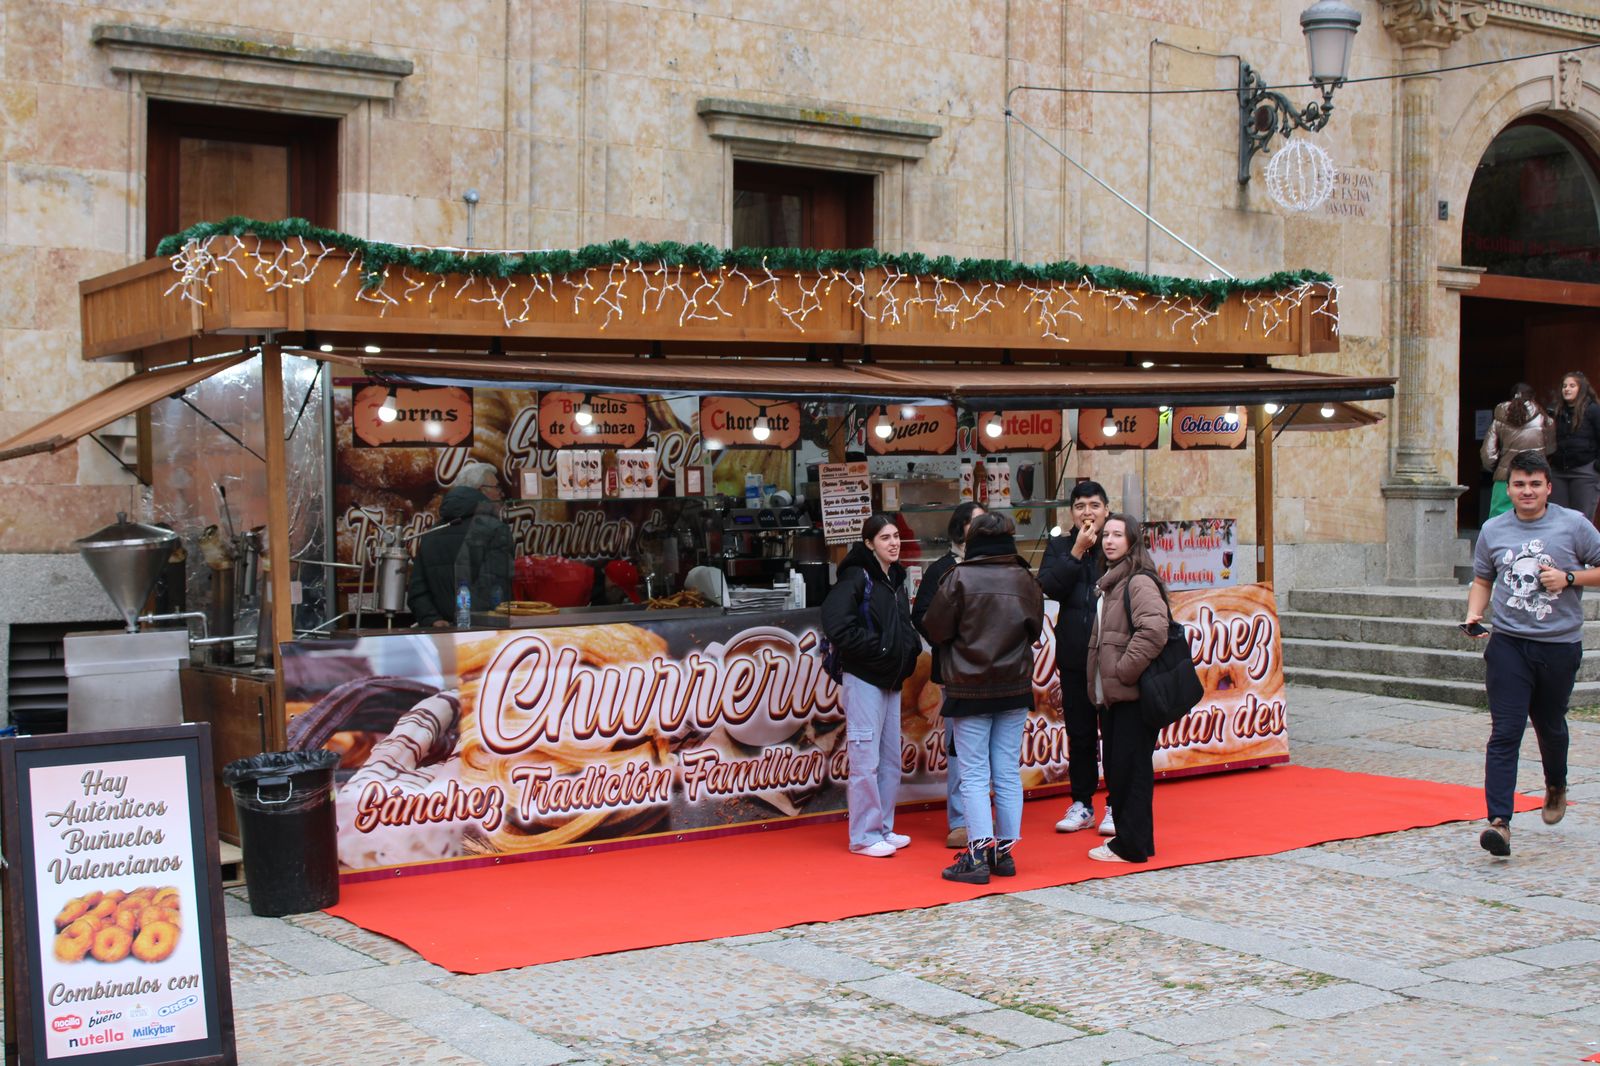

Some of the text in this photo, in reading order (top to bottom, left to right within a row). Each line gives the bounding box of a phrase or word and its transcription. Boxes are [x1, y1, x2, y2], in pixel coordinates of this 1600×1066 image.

[559, 399, 628, 414] Buuelos
[549, 421, 565, 434] de
[988, 414, 1053, 436] utella
[1101, 415, 1137, 433] afé
[1180, 415, 1240, 433] Cola Cao
[1184, 606, 1273, 681] chez
[80, 769, 128, 797] Hay
[355, 780, 504, 834] Sánchez
[512, 759, 672, 821] Tradición
[683, 746, 823, 801] Familiar
[45, 798, 168, 828] Auténticos
[60, 825, 165, 854] Buñuelos
[47, 854, 183, 884] Valencianos
[48, 972, 200, 1006] Combínalos con
[158, 995, 198, 1017] OREO
[54, 1017, 81, 1028] nocilla
[89, 1011, 122, 1028] bueno
[69, 1029, 124, 1048] nutella
[132, 1024, 176, 1038] Milkybar
